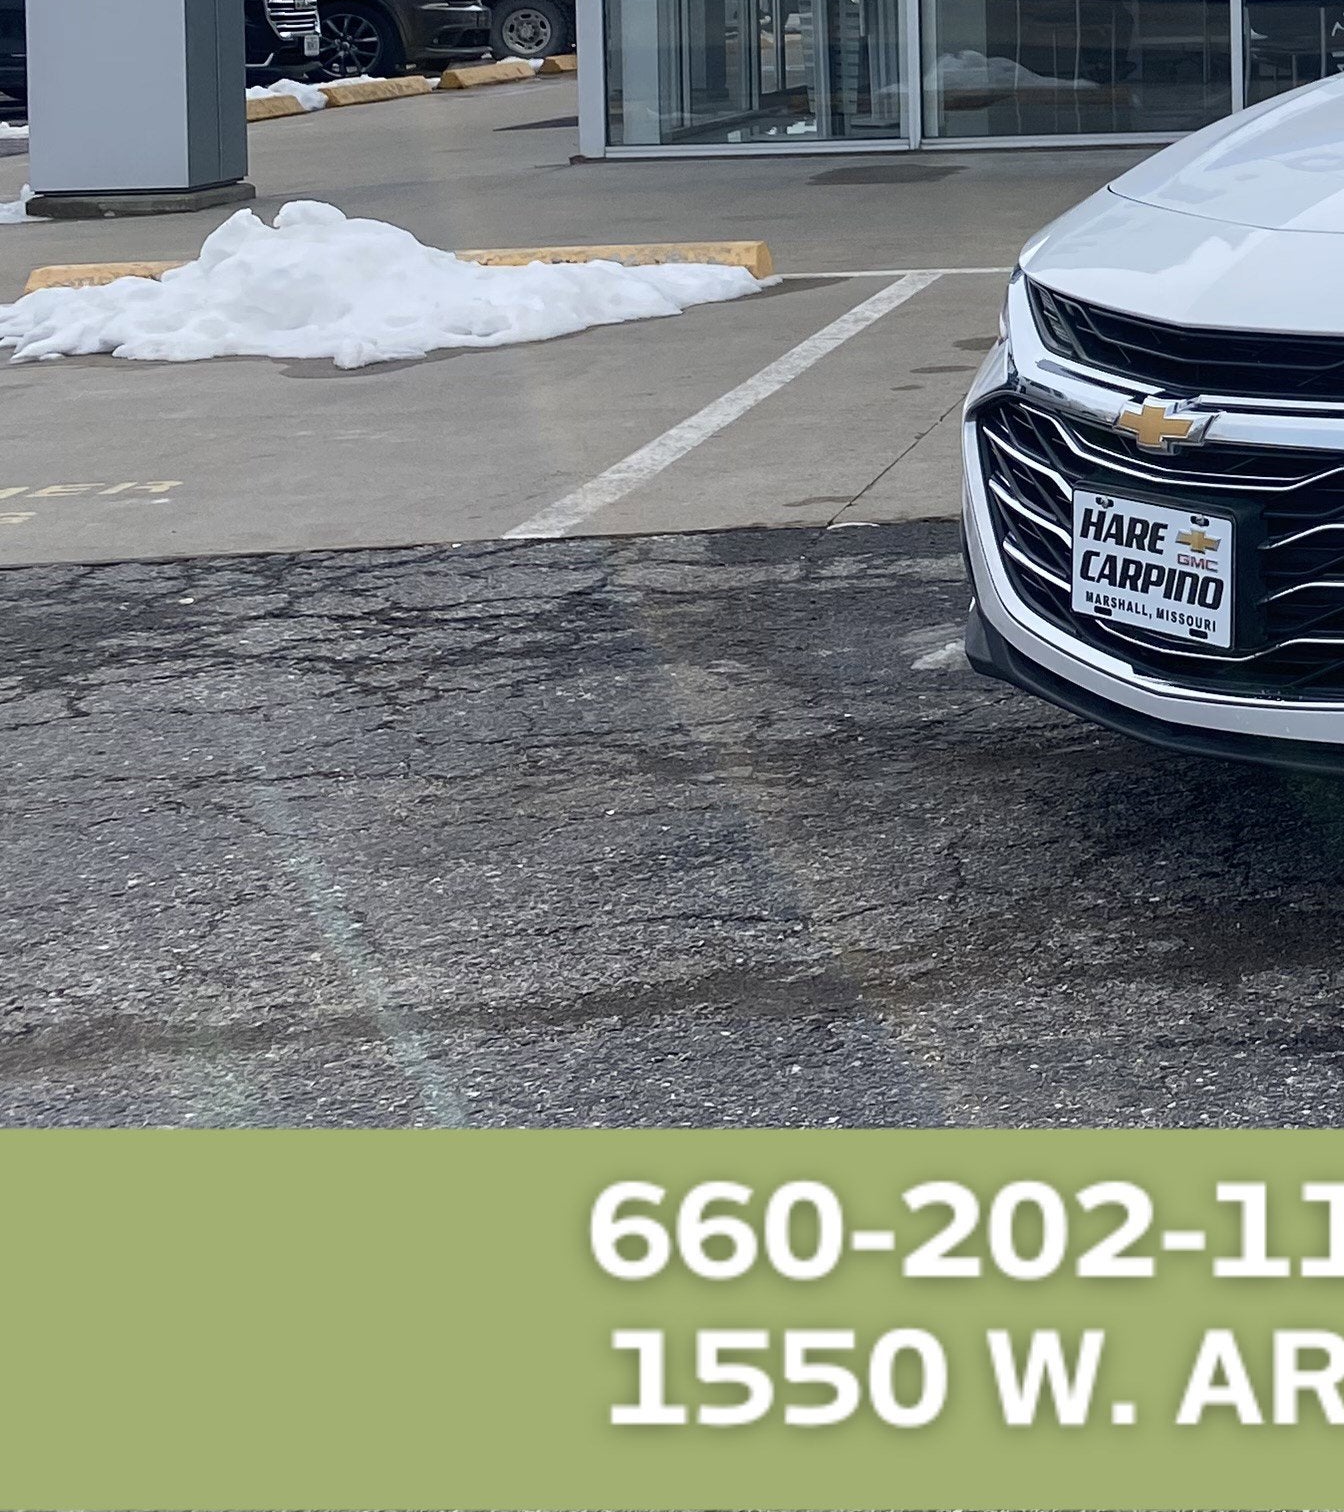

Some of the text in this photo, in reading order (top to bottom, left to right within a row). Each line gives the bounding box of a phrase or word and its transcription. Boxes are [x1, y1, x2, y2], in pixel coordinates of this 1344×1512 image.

[1080, 507, 1168, 555] HARE
[1080, 549, 1225, 611] CARPINO
[1177, 553, 1219, 574] GMC
[1085, 590, 1217, 633] MARSHALL, MISSOURI
